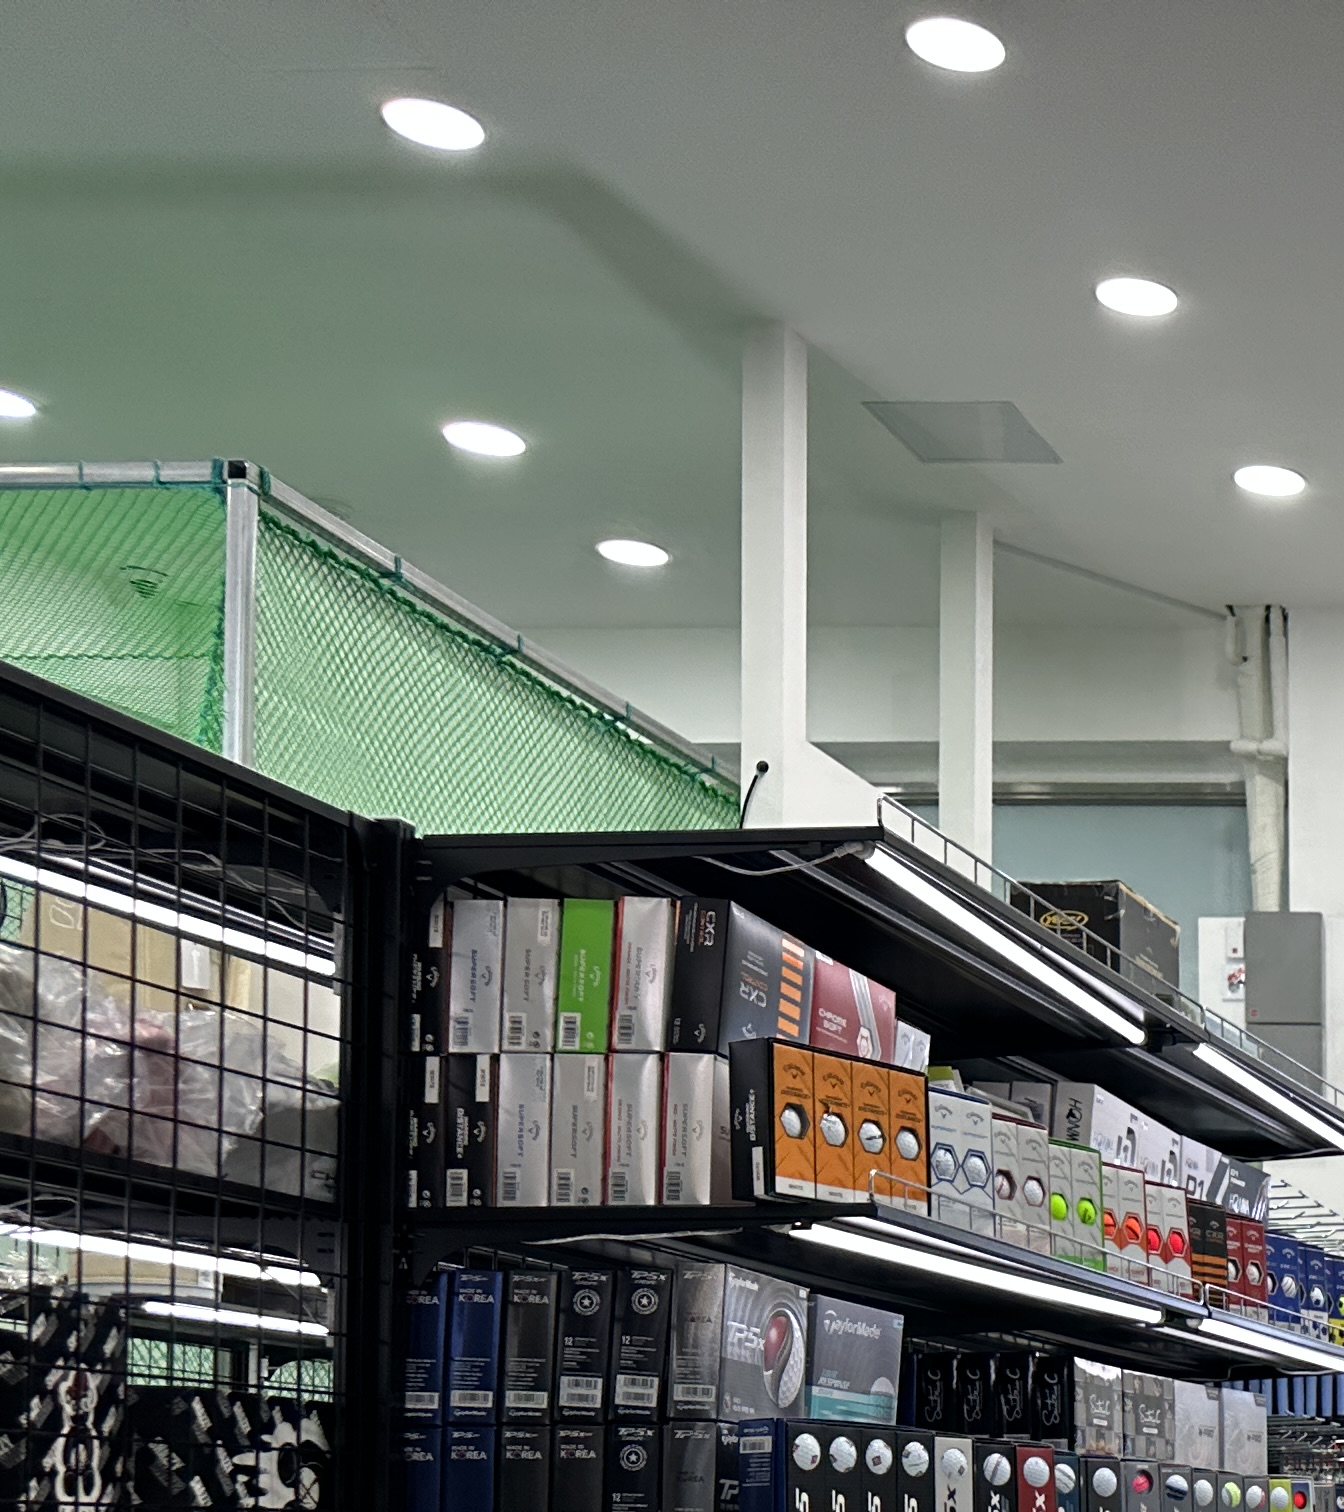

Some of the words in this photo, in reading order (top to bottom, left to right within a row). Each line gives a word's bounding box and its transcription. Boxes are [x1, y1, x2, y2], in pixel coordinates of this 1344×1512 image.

[703, 910, 716, 946] CXR
[739, 981, 767, 1008] CXR
[458, 1293, 495, 1304] KOREA
[513, 1294, 549, 1304] KOREA
[824, 1310, 881, 1340] TaylorMade
[621, 1334, 631, 1345] 12
[727, 1321, 765, 1351] TP5x
[450, 1450, 487, 1460] KOREA
[505, 1450, 542, 1460] KOREA
[560, 1449, 597, 1458] KOREA
[719, 1478, 740, 1501] TP
